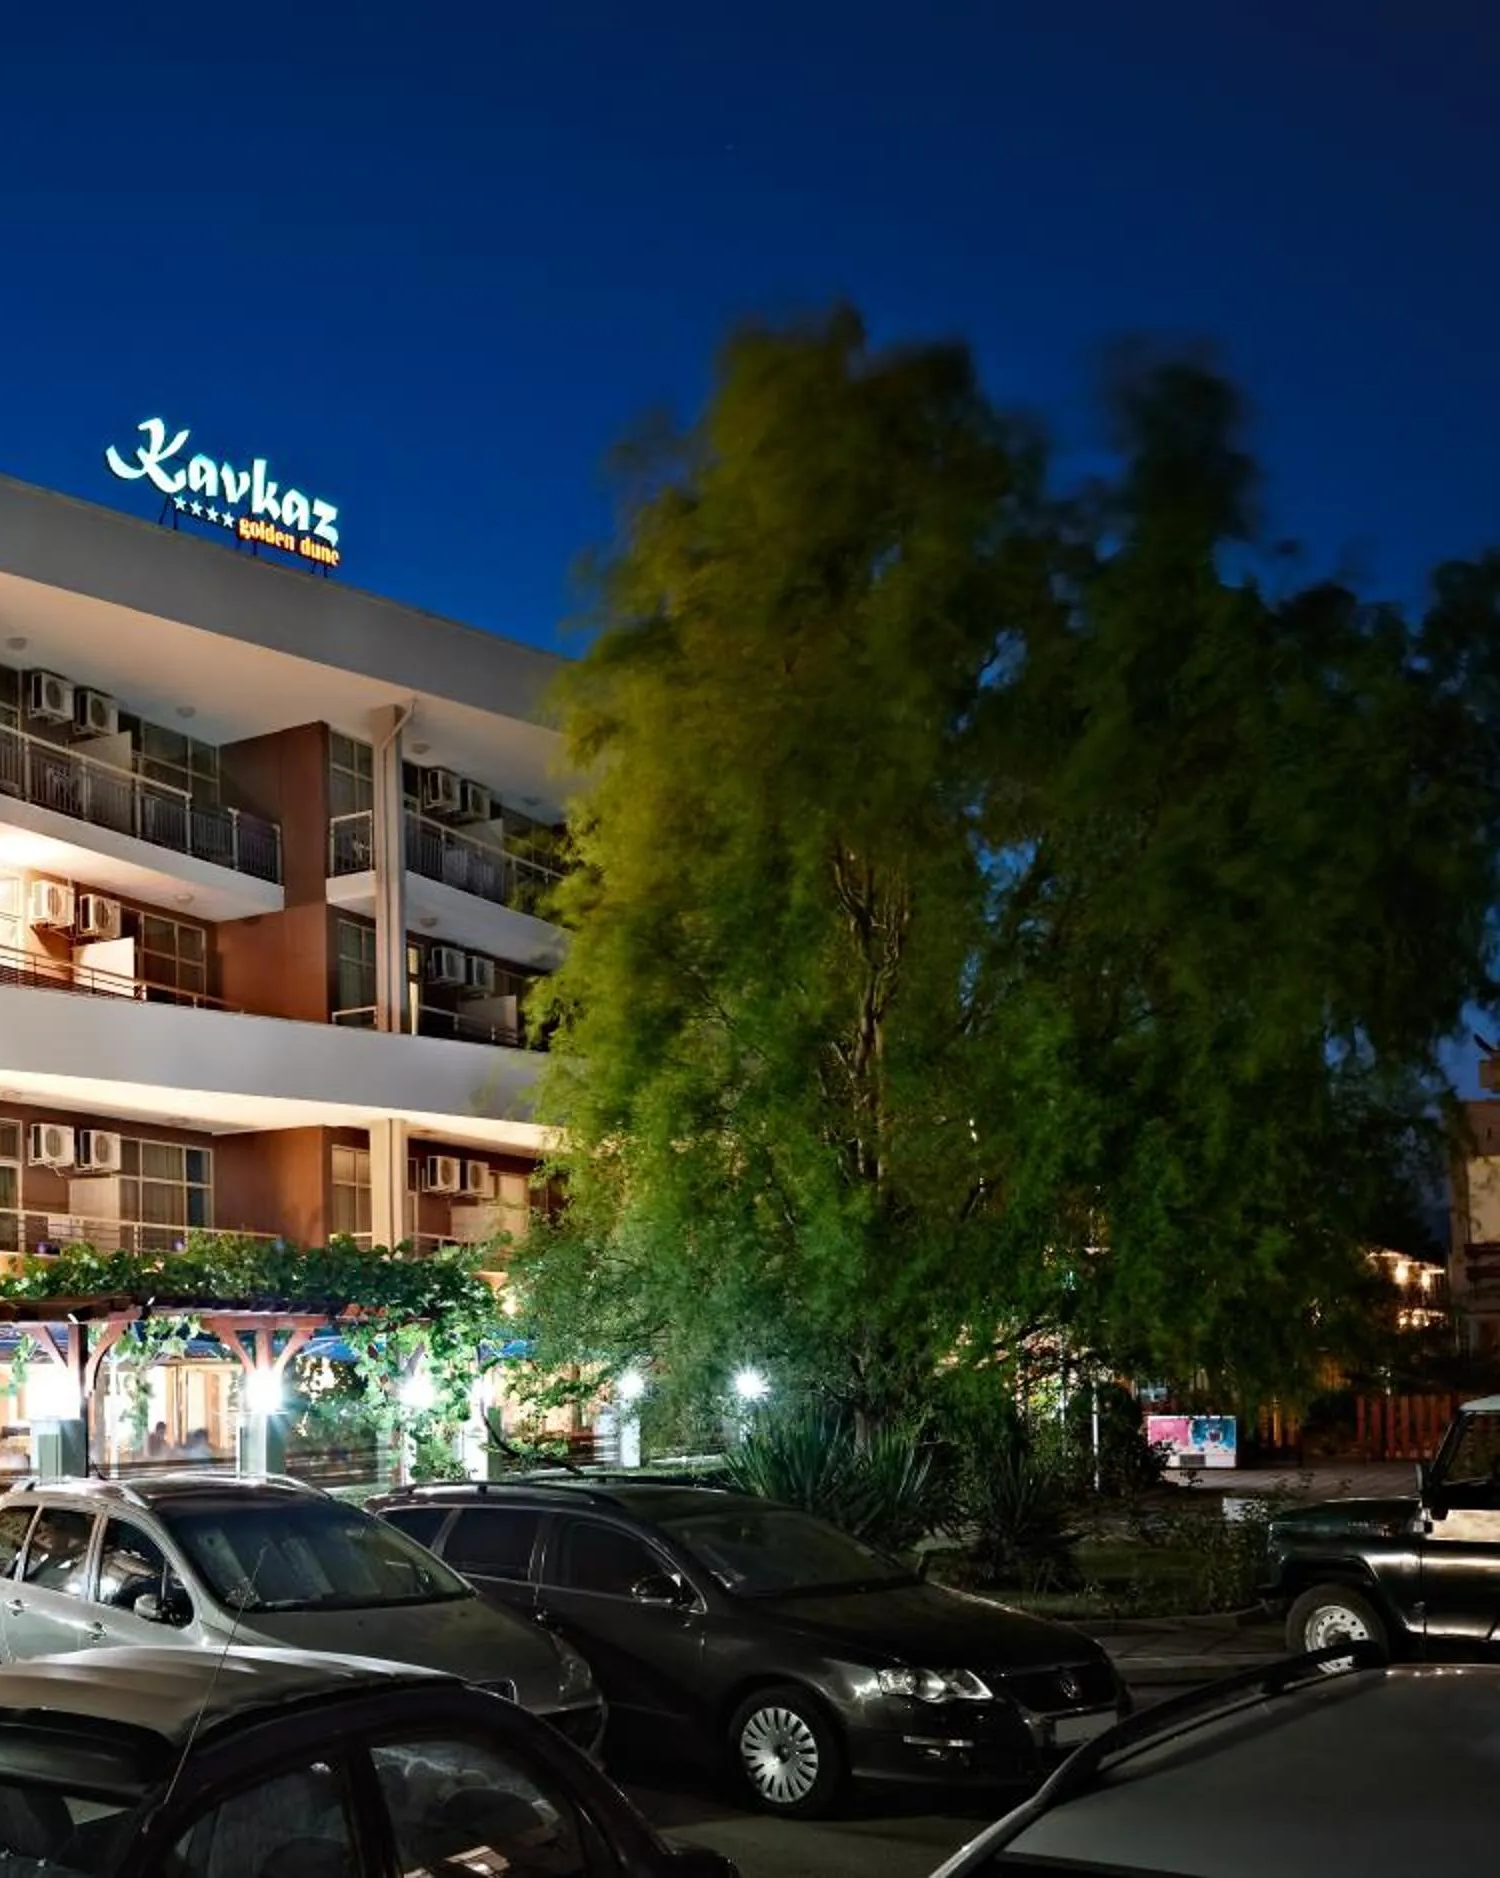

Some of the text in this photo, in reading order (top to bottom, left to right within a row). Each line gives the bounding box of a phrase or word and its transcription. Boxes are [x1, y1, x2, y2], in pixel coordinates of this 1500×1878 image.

[106, 417, 339, 547] Kavkaz
[239, 517, 340, 566] golden dune
